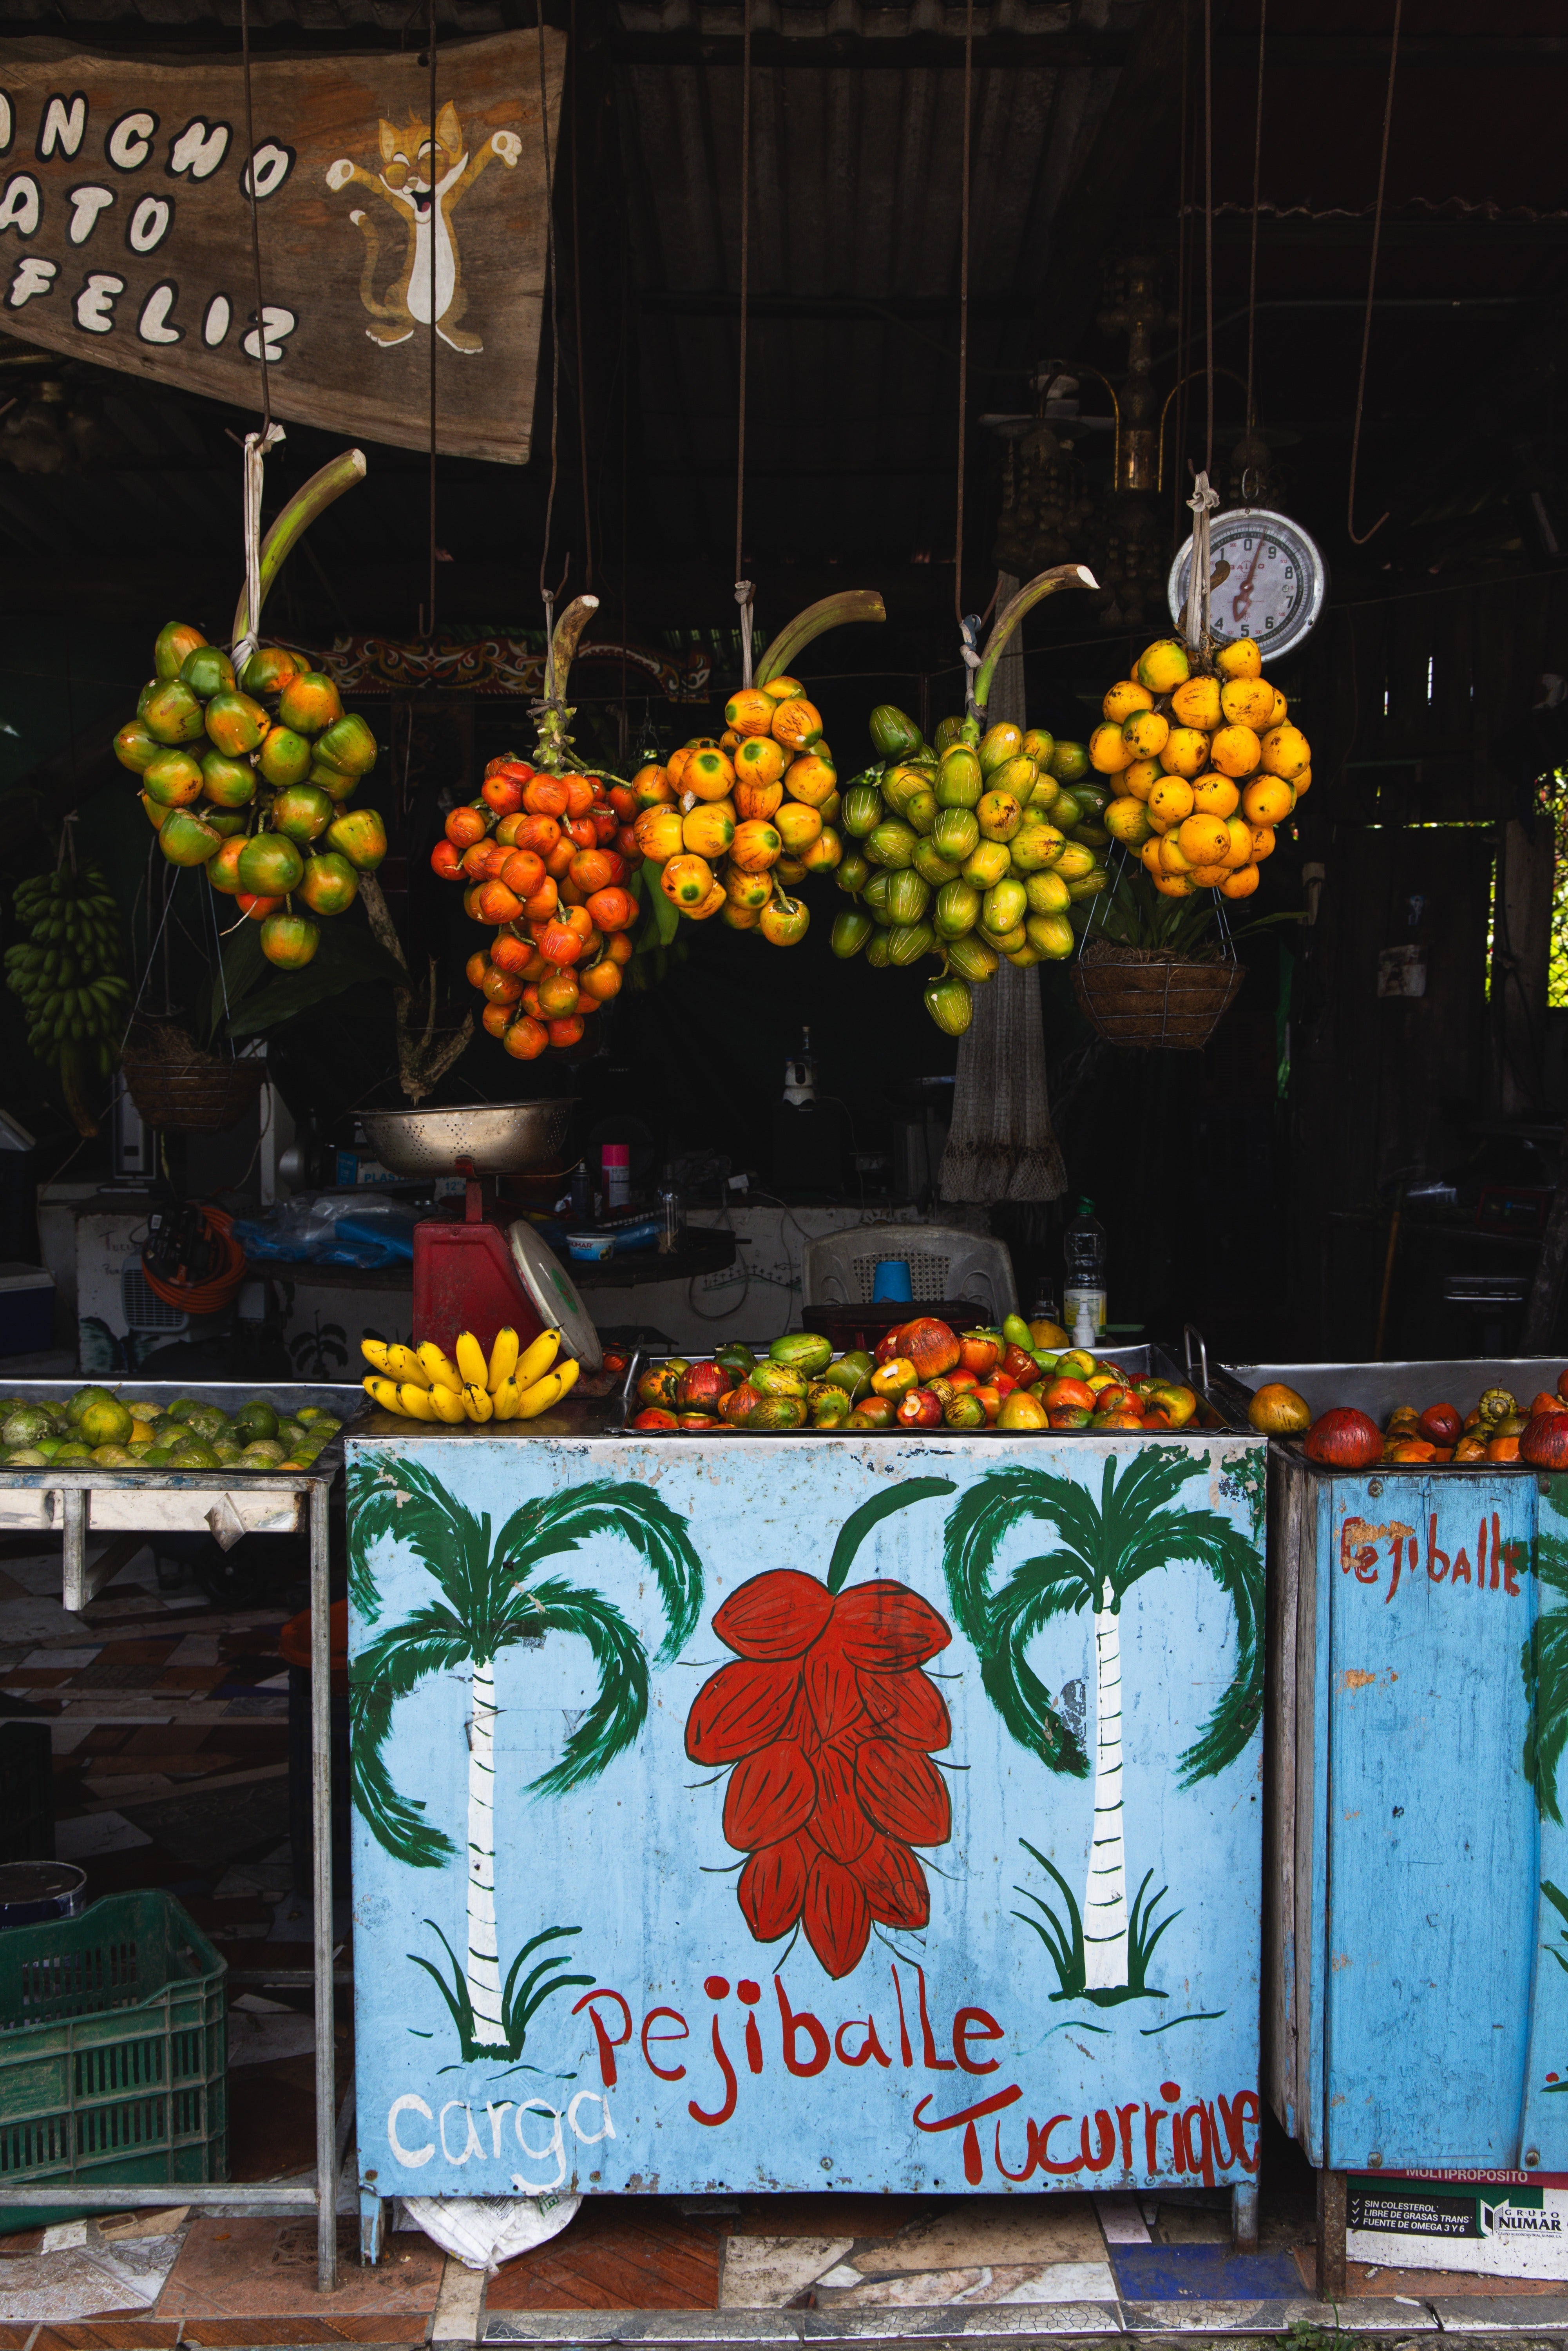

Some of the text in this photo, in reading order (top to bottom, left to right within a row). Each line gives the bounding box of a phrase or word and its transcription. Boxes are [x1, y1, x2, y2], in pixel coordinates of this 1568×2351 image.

[6, 257, 295, 361] FELIZ
[1268, 546, 1276, 559] 9
[1285, 566, 1293, 579] 8
[1286, 596, 1293, 608] 7
[1215, 618, 1223, 630] 4
[1266, 616, 1273, 629] 6
[1241, 625, 1249, 637] 5
[913, 2081, 1259, 2187] Tucurrique
[388, 2090, 616, 2195] carga
[1364, 2200, 1380, 2208] SIN
[1364, 2209, 1389, 2218] LIBRE
[1403, 2212, 1438, 2221] GRASAS
[1505, 2209, 1559, 2218] GRUPO
[1363, 2218, 1396, 2228] FUENTE
[1398, 2221, 1409, 2229] DE
[1411, 2222, 1442, 2231] OMEGA
[1498, 2217, 1562, 2231] NUMAR
